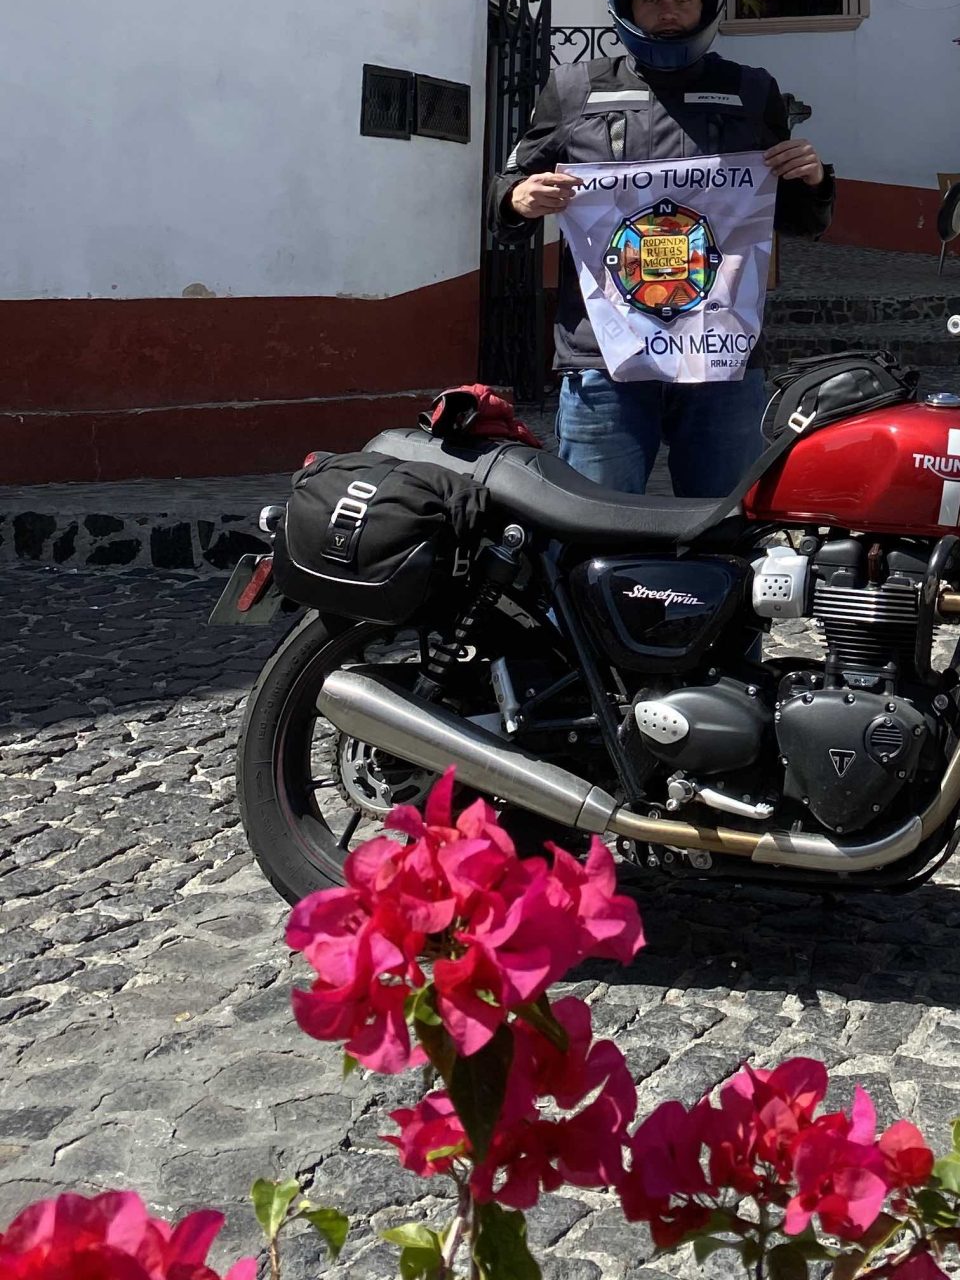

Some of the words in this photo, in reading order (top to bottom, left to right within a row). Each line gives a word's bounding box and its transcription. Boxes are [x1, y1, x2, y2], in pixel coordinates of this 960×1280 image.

[660, 167, 754, 190] TURISTA
[660, 203, 672, 214] N
[709, 254, 719, 264] E
